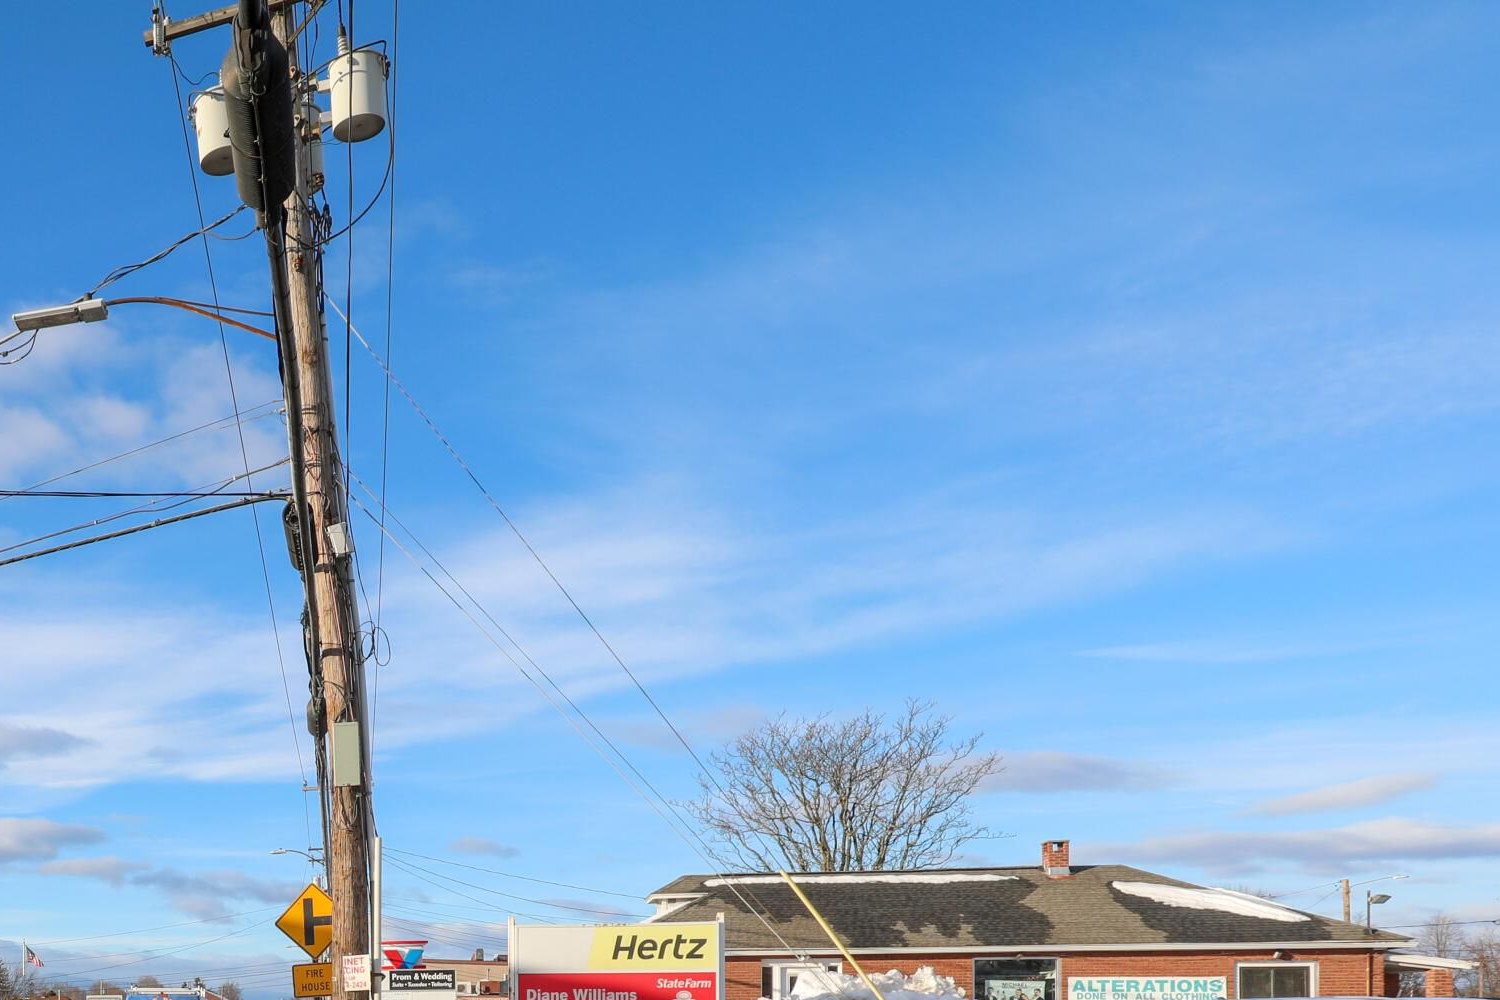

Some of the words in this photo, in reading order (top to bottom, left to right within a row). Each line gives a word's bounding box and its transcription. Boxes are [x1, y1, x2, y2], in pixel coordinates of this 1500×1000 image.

[611, 934, 707, 960] Hertz
[305, 968, 324, 978] FIRE
[391, 972, 412, 981] Prom
[413, 972, 420, 980] &
[420, 972, 453, 982] Wedding
[301, 981, 331, 992] HOUSE
[1072, 979, 1224, 993] ALTERATIONS
[1076, 992, 1107, 1000] DONE
[1112, 992, 1128, 1000] ON
[1135, 992, 1155, 1000] ALL
[1161, 992, 1219, 1000] CLOTHING
